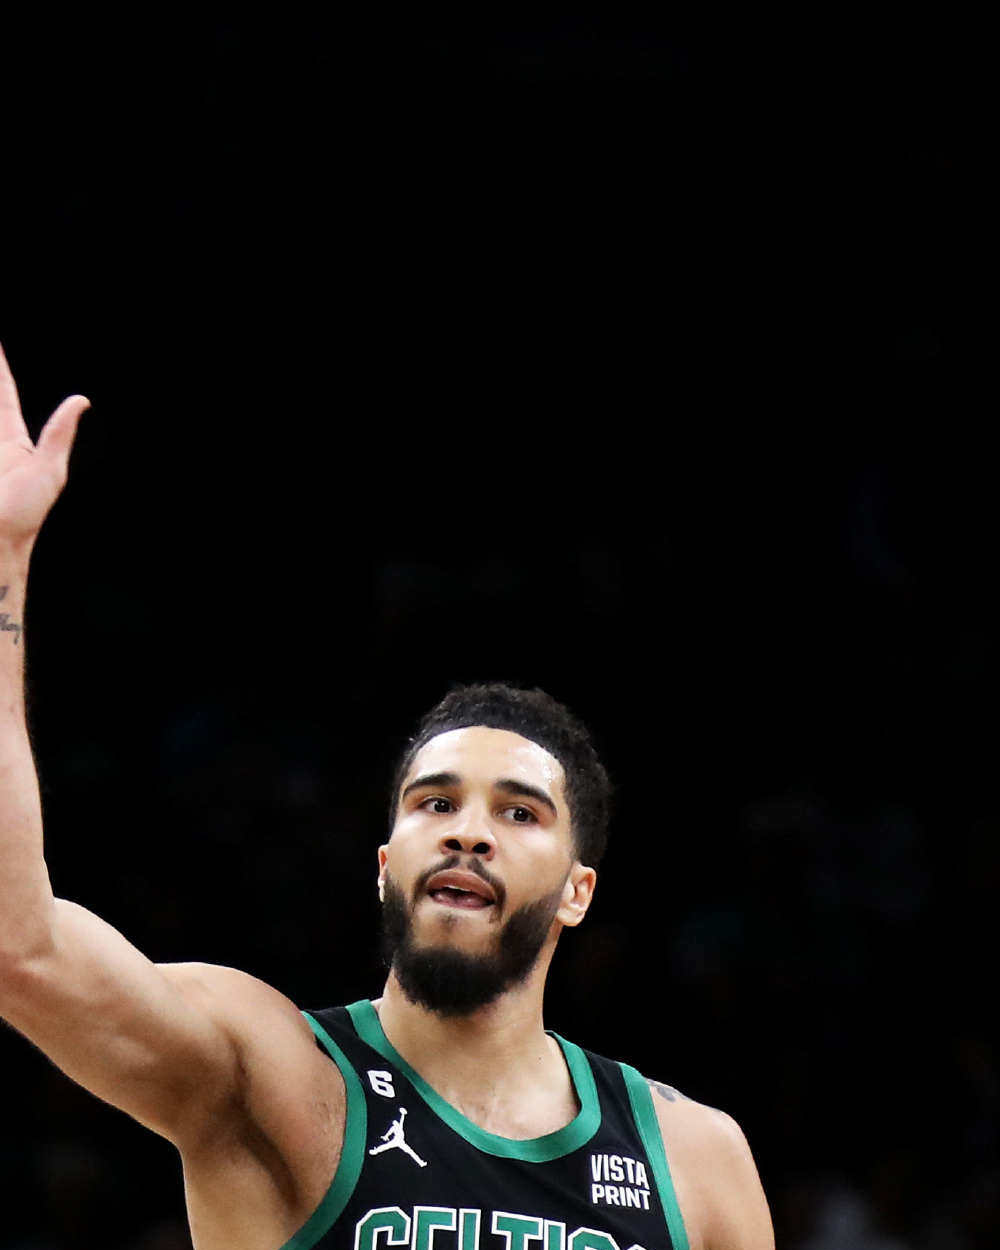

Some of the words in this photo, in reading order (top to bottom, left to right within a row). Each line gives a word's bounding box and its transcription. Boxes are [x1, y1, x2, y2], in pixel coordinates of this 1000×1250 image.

[367, 1070, 396, 1098] 6
[591, 1154, 650, 1190] VISTA
[592, 1183, 651, 1210] PRINT
